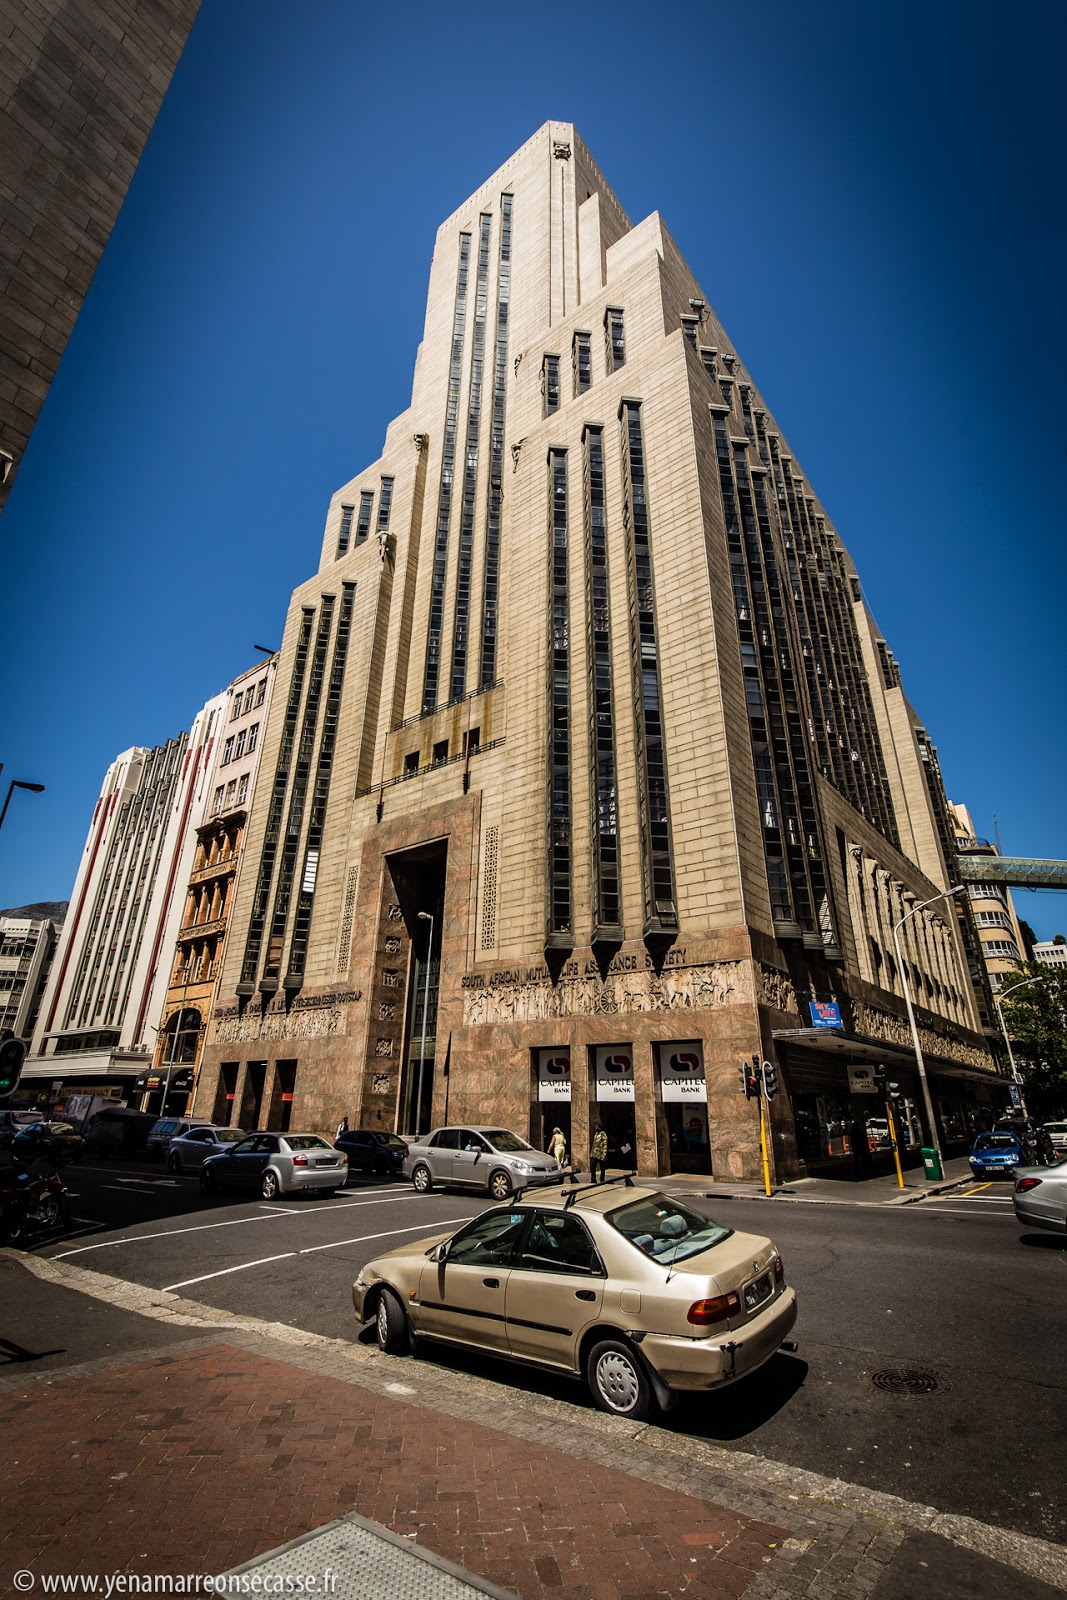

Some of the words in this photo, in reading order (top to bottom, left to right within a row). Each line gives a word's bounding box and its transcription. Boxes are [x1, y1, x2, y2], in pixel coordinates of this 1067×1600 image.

[461, 973, 485, 988] SOUTH
[489, 968, 520, 986] AFRICAN
[526, 965, 551, 981] MUTUA
[585, 954, 637, 975] ASSRANCE
[645, 947, 687, 969] SIETY
[540, 1079, 570, 1087] CAPITE
